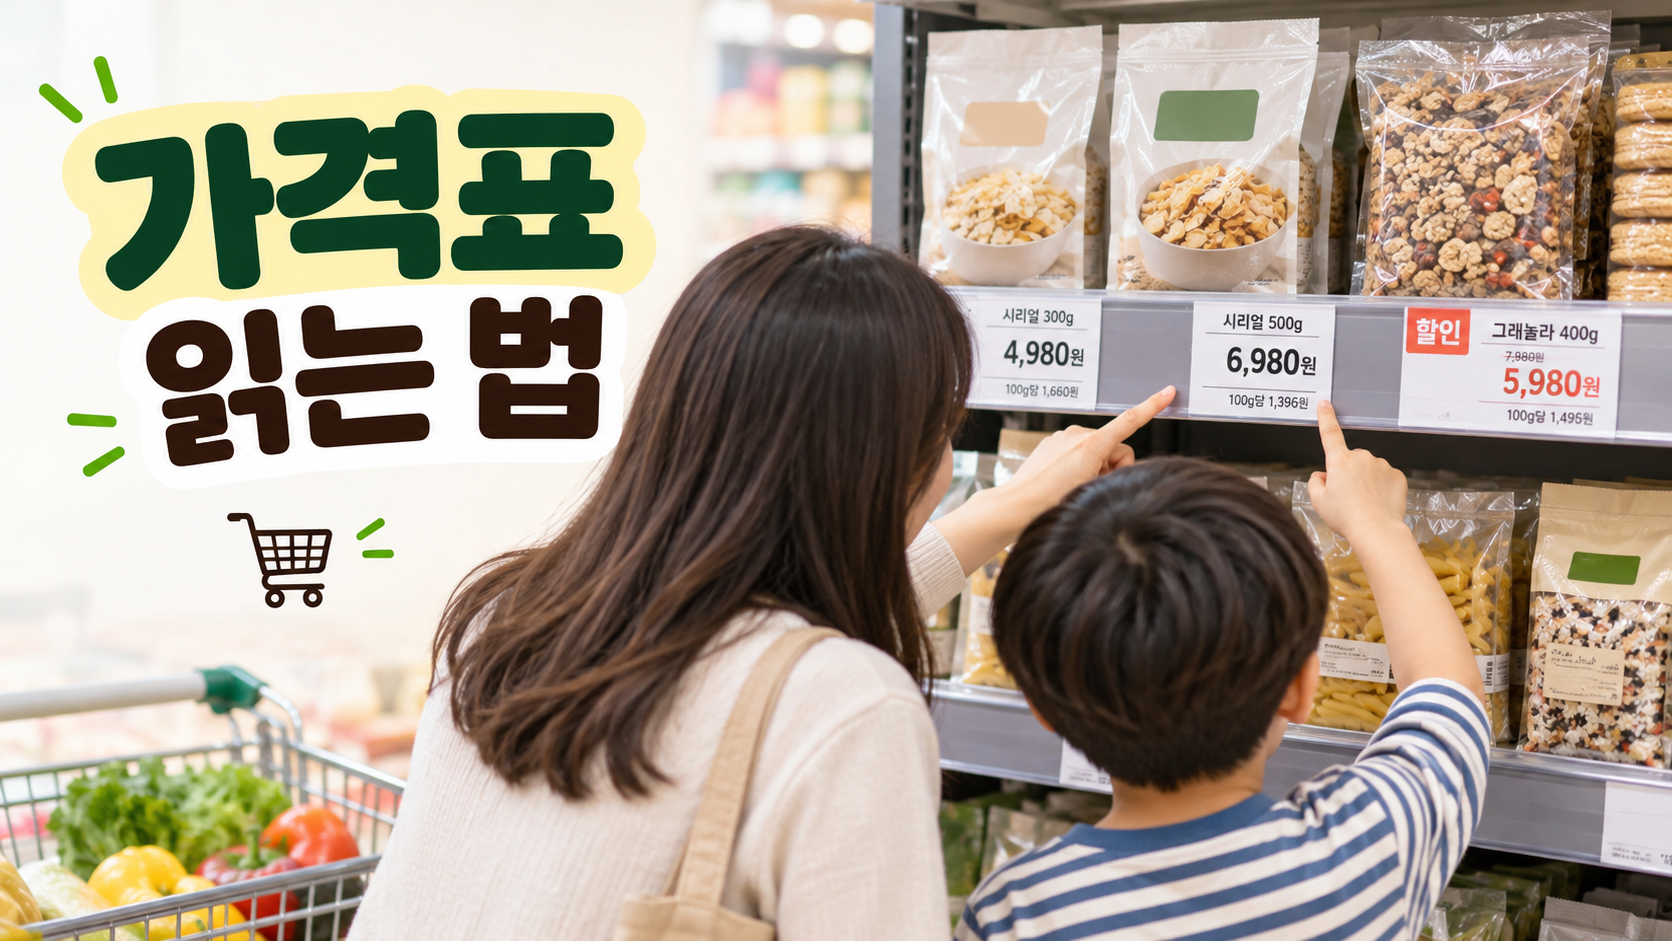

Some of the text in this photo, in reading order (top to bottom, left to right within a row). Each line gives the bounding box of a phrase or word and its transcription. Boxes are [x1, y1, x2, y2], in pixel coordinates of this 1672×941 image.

[1002, 308, 1074, 327] 시리얼 300g
[1223, 313, 1303, 333] 시리얼 500g
[1416, 318, 1461, 346] 할인
[1491, 322, 1599, 344] 그래놀라 400g
[1003, 339, 1085, 369] 4,980원
[1226, 346, 1317, 378] 6,980원
[1042, 385, 1079, 399] 1,660원
[1503, 367, 1600, 399] 5,980원
[1229, 394, 1309, 410] 100g당 1,396원
[1507, 409, 1546, 424] 100g당
